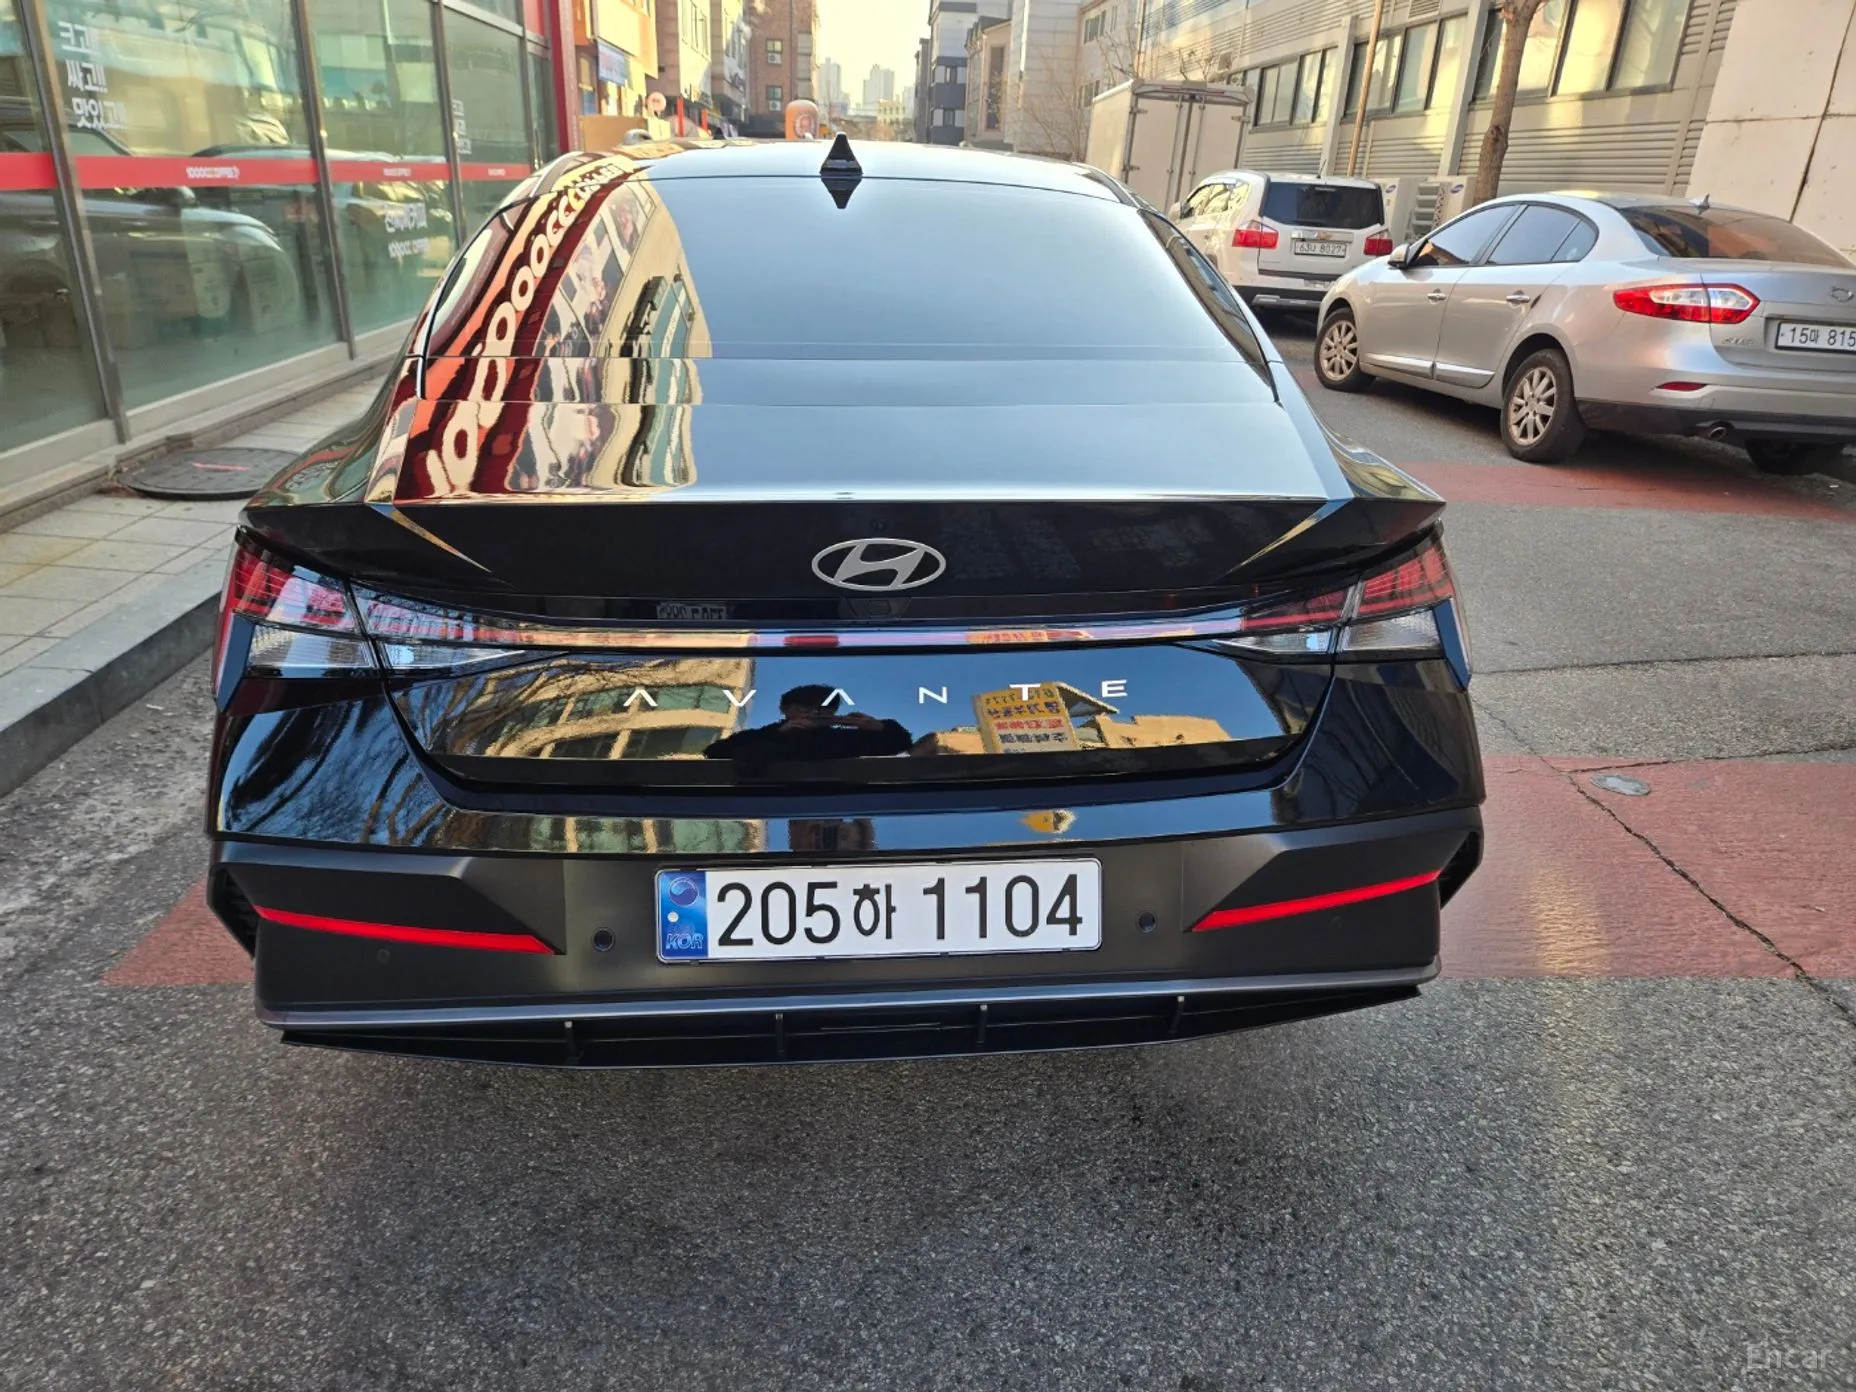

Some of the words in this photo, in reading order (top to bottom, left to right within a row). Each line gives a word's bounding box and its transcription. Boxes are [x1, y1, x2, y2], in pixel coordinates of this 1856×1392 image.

[716, 880, 897, 947] 205하
[922, 873, 1084, 941] 1104
[665, 933, 704, 950] KOR
